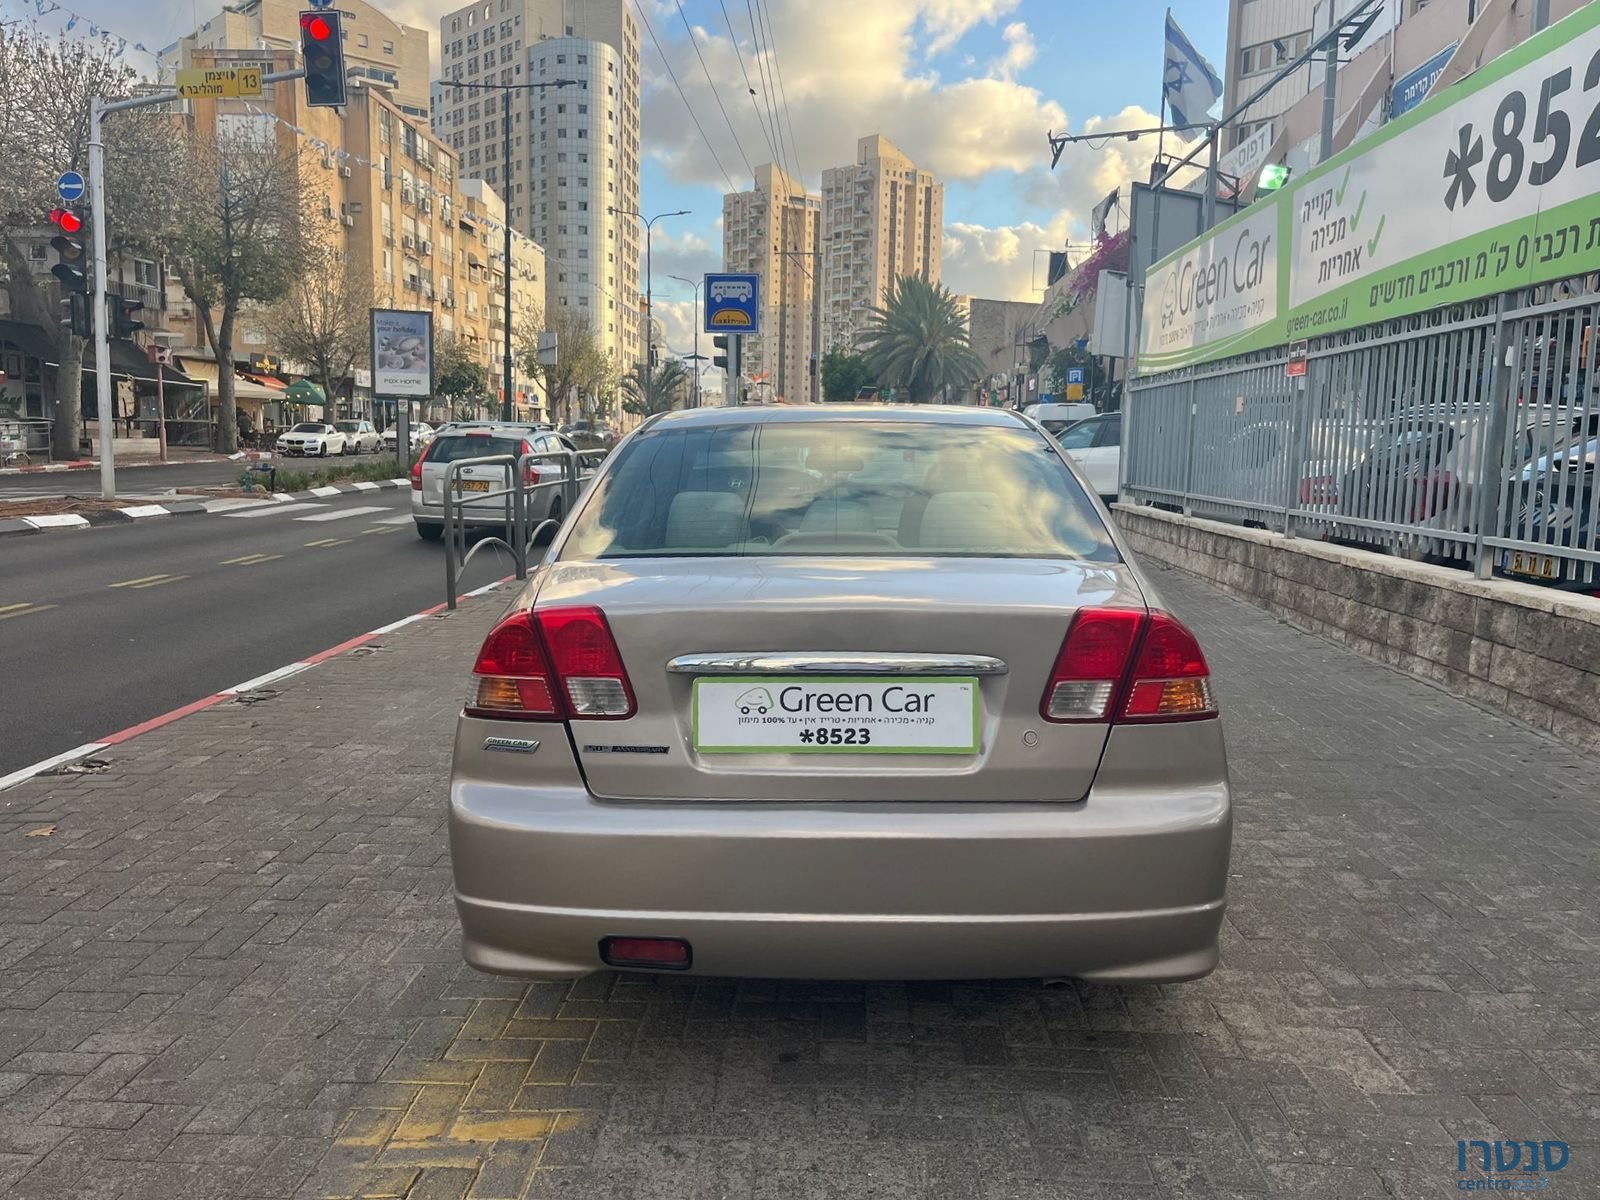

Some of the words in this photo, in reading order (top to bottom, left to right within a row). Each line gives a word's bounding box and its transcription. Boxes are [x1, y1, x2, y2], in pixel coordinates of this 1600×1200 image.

[205, 71, 229, 83] ויצמן
[242, 74, 258, 88] 13
[1404, 76, 1428, 102] קדימה
[1238, 132, 1265, 167] דפוס
[1302, 188, 1333, 223] קנייה
[1310, 216, 1346, 252] מכירה
[1534, 224, 1580, 263] רכבי
[1179, 256, 1228, 317] Green
[1233, 228, 1271, 294] Car
[1318, 246, 1362, 284] אחריות
[1418, 256, 1470, 294] ורכבים
[1369, 274, 1415, 308] חדשים
[1286, 296, 1349, 338] green-car.co.il
[780, 686, 872, 712] Green
[882, 686, 935, 712] Car
[916, 717, 935, 726] קניה
